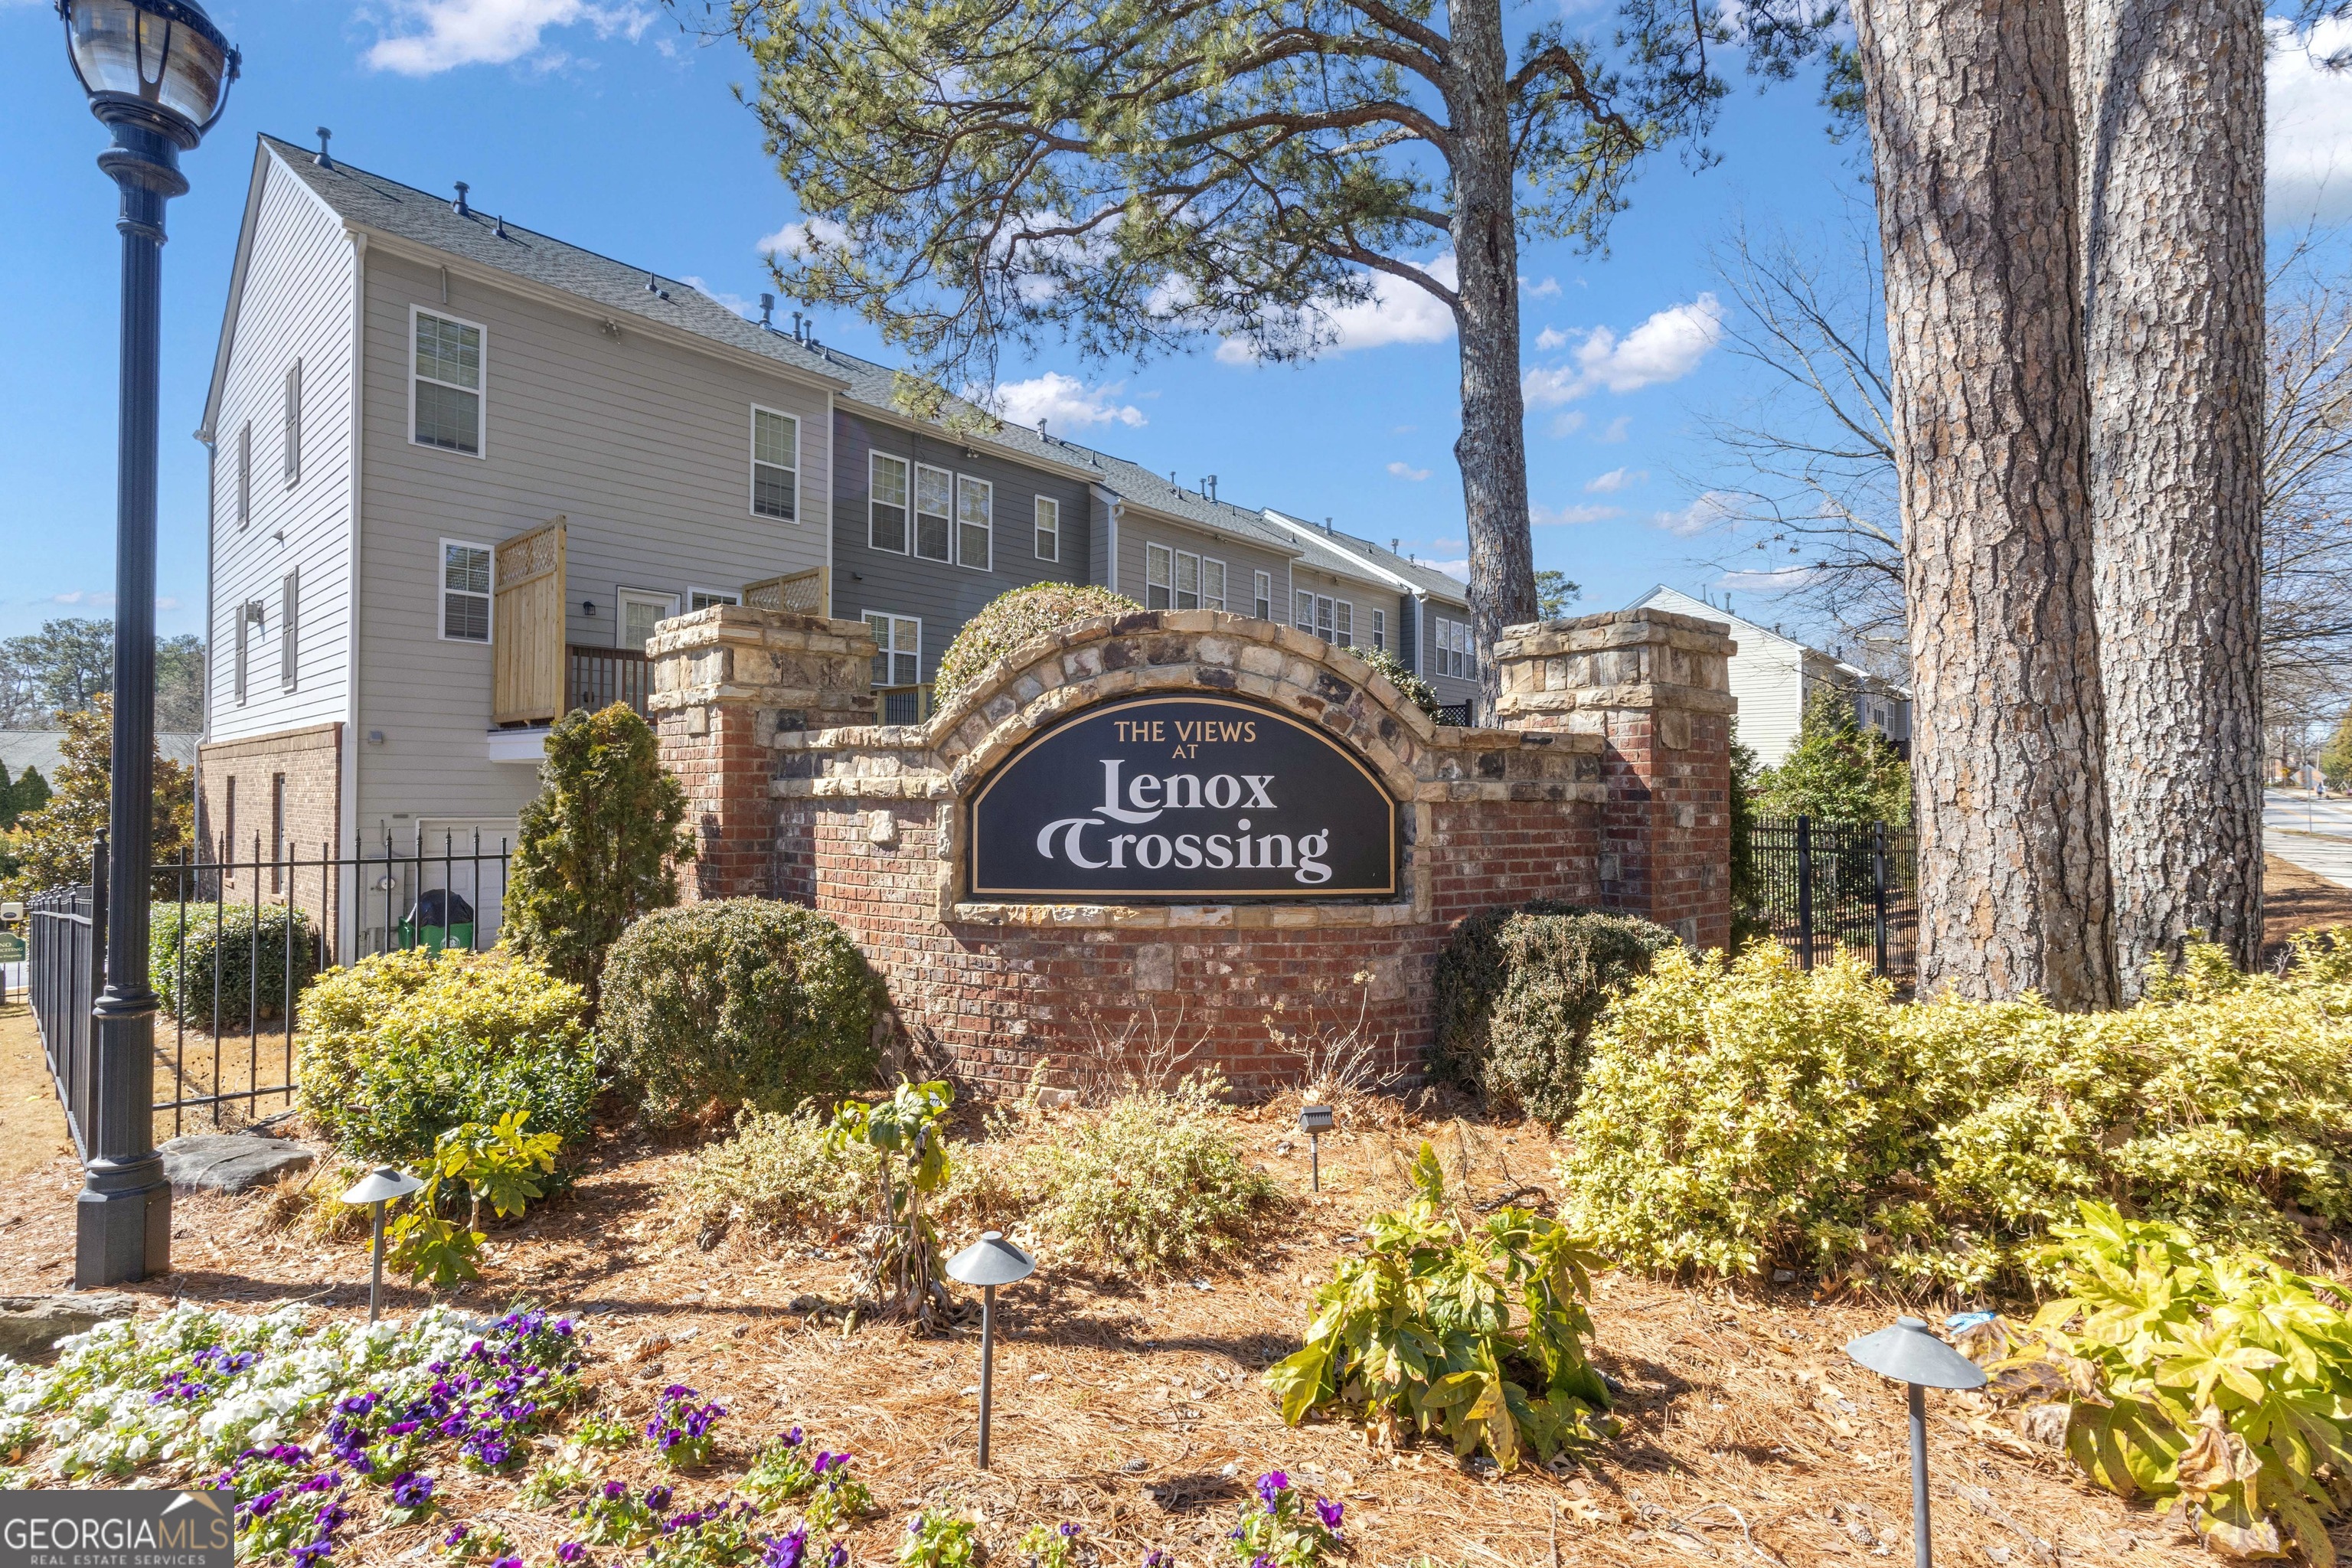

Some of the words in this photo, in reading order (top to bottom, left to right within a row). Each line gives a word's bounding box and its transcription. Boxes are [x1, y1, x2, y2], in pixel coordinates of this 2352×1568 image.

[1114, 721, 1165, 742] THE
[1174, 720, 1256, 743] VIEWS
[1171, 744, 1198, 759] AT
[1092, 760, 1277, 824] Lenox
[1037, 818, 1332, 884] Crossing
